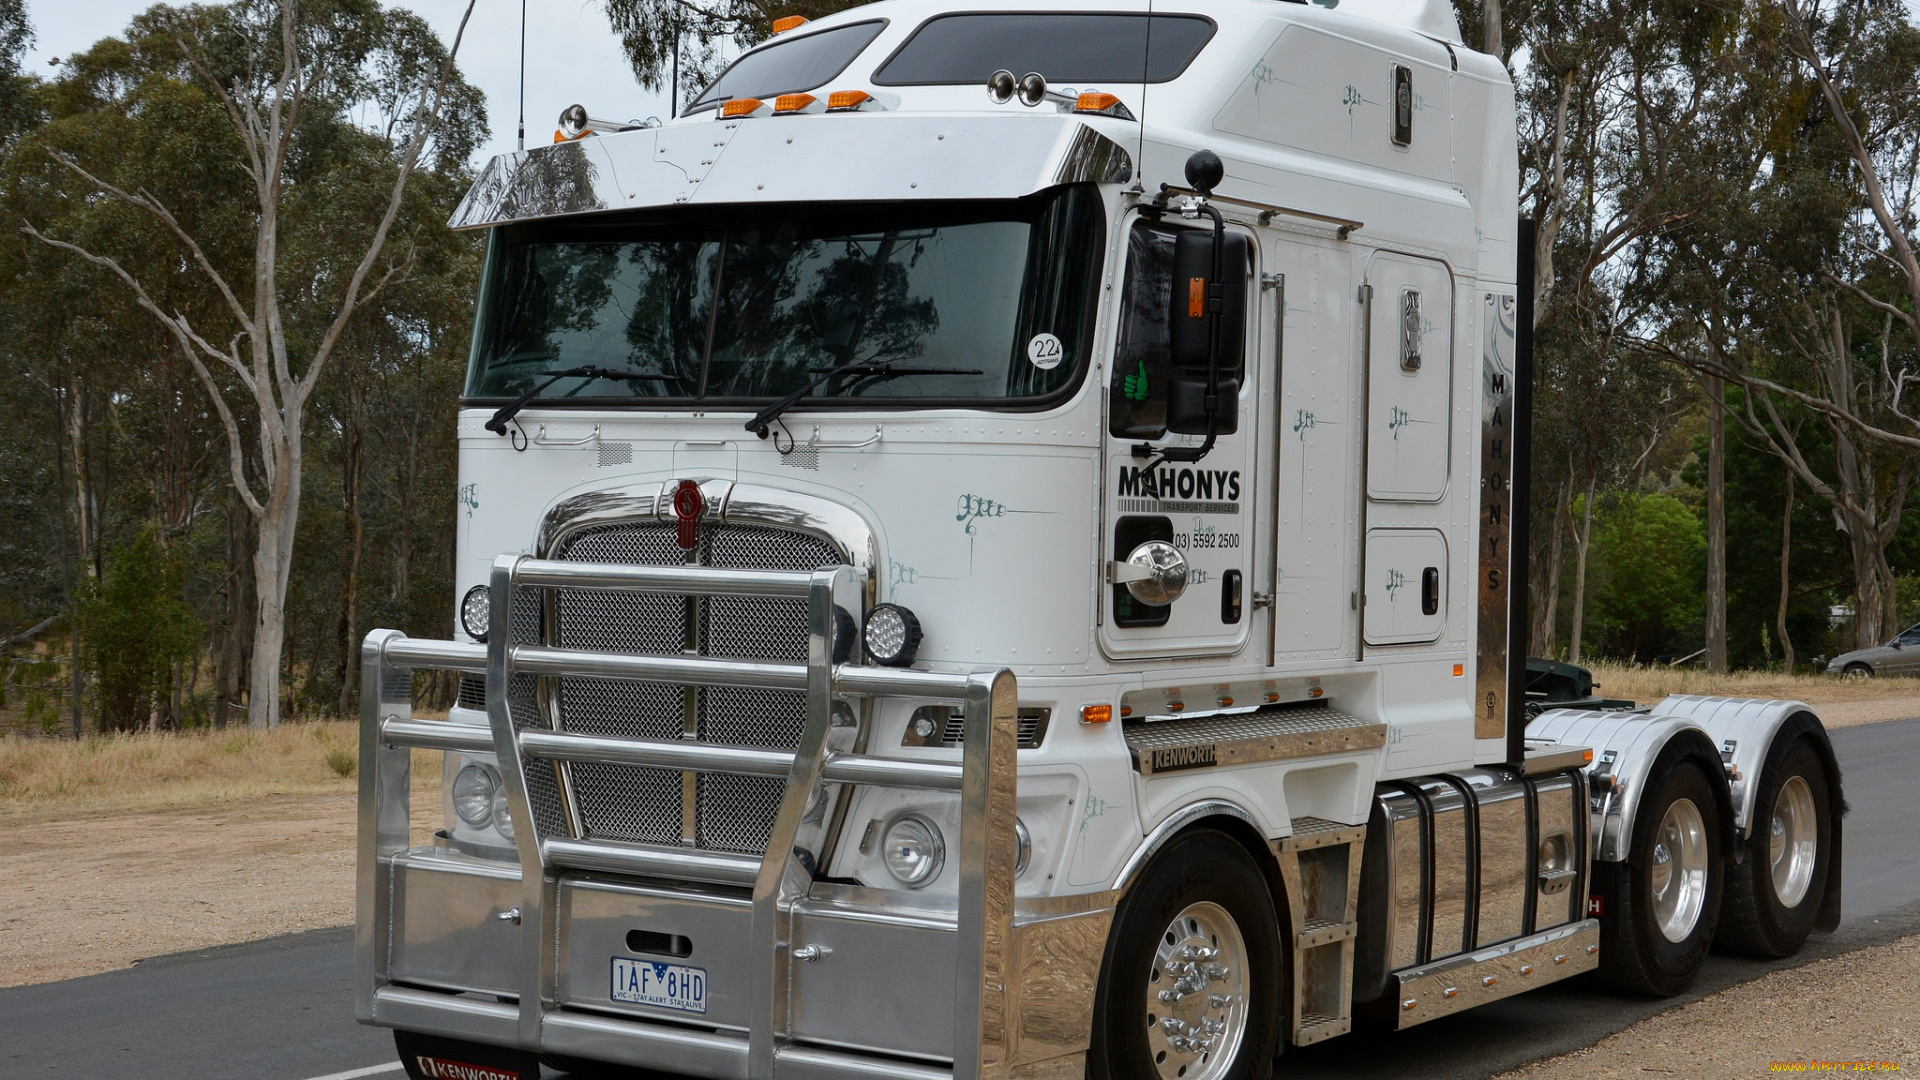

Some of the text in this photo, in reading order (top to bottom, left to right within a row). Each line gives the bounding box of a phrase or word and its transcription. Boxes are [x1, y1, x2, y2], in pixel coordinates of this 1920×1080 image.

[1034, 338, 1056, 358] 22
[1118, 465, 1240, 501] MAHONYS
[1488, 373, 1505, 591] MAHONYS
[1162, 502, 1236, 513] TRANSPORT SERVICES
[1193, 533, 1216, 549] 5592
[1218, 533, 1240, 549] 2500
[1156, 744, 1217, 768] KENWORTH
[619, 965, 703, 1001] 1AF 8HD
[437, 1062, 517, 1080] KENWOR
